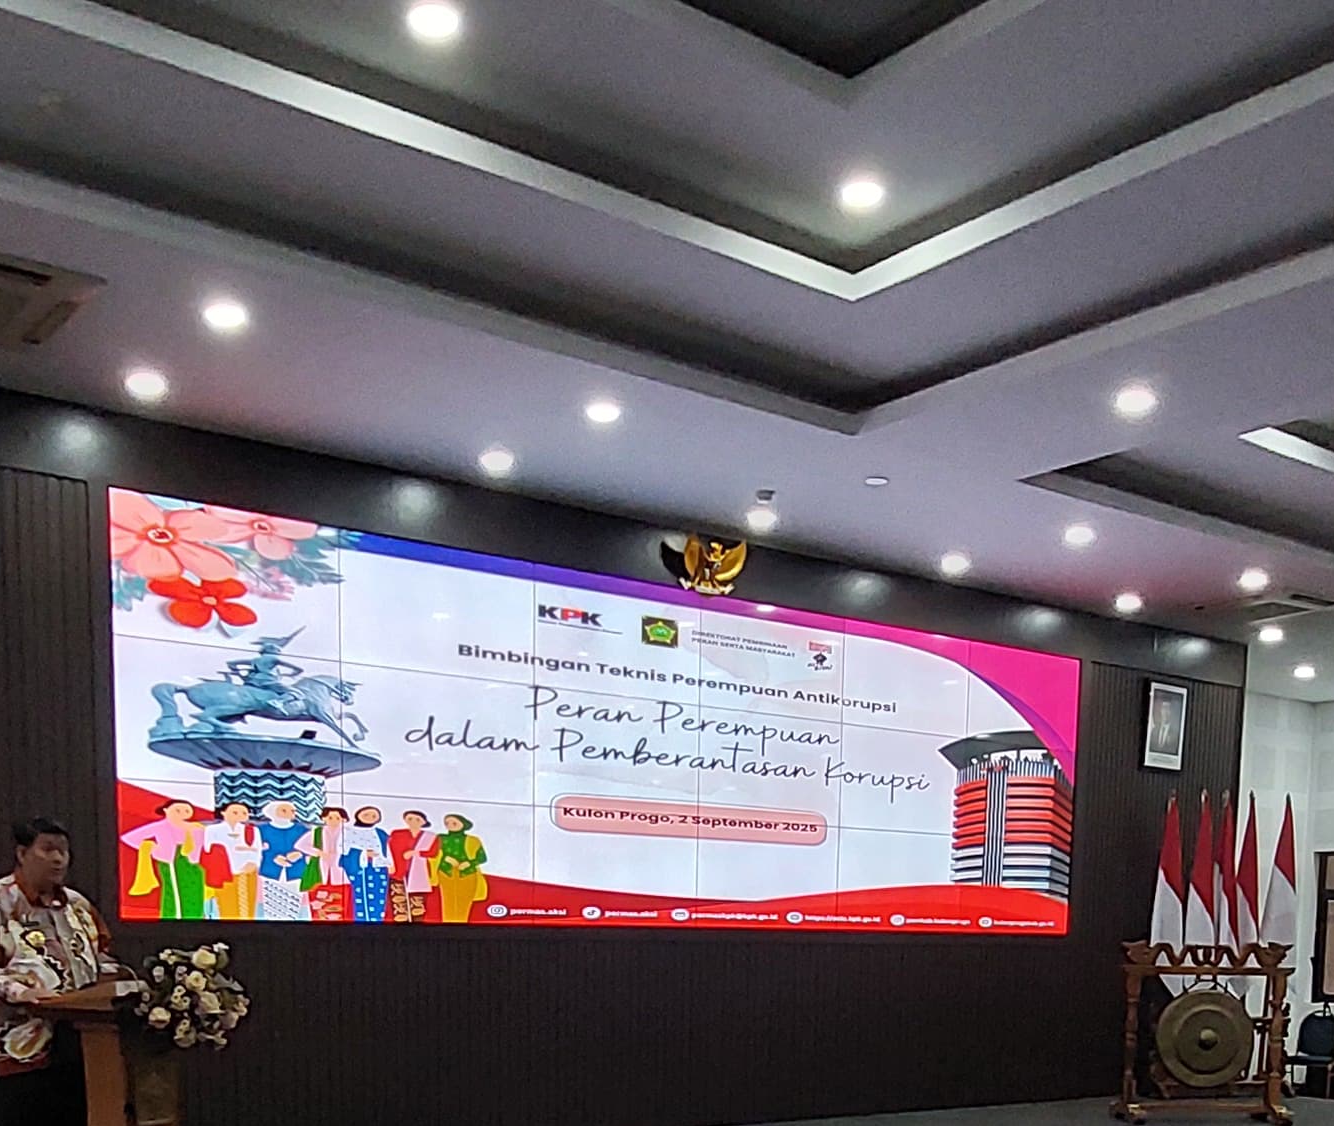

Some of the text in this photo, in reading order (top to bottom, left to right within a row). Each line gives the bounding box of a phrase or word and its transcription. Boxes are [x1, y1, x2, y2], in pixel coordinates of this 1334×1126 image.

[538, 604, 603, 627] KPK
[458, 644, 897, 713] Bimbingan Teknis Perempuan Antikorupsi
[524, 685, 839, 756] Peran Perempuan
[404, 716, 931, 803] dalam Pemberantasan Korupsi
[563, 807, 818, 833] Kulon Progo, 2 September 2025
